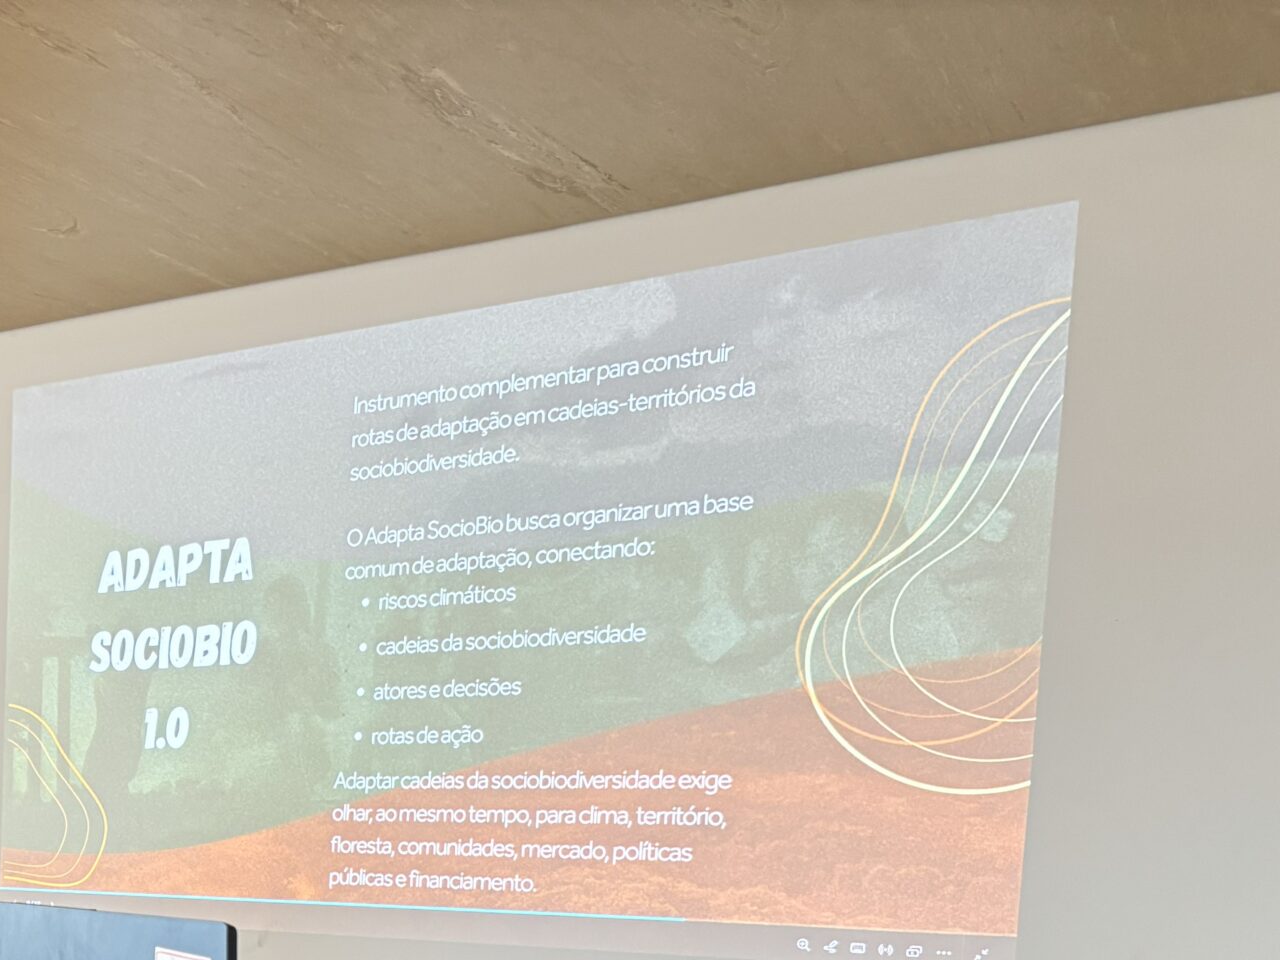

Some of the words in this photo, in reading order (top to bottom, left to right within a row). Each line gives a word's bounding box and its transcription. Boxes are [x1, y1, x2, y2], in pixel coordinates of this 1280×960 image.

[354, 385, 457, 414] Instrumento
[460, 366, 595, 399] complementar
[597, 361, 639, 385] para
[642, 343, 734, 373] construir
[352, 429, 393, 447] rotas
[396, 423, 418, 441] de
[420, 412, 512, 440] adaptação
[514, 410, 545, 426] em
[548, 384, 726, 422] cadeias-territórios
[729, 377, 755, 398] da
[350, 444, 520, 481] sociobiodiversidade.
[347, 528, 363, 547] O
[365, 524, 424, 547] Adapta
[428, 516, 503, 539] SocioBio
[506, 514, 560, 532] busca
[563, 504, 653, 530] organizar
[655, 500, 699, 518] uma
[704, 494, 754, 514] base
[97, 537, 253, 593] ADAPTA
[345, 562, 409, 580] comum
[412, 556, 434, 574] de
[436, 548, 532, 575] adaptação,
[536, 537, 655, 564] conectando:
[379, 593, 427, 610] riscos
[429, 585, 516, 607] climáticos
[89, 620, 257, 673] SOCIOBIO
[377, 636, 438, 655] cadeias
[441, 633, 463, 652] da
[465, 623, 647, 651] sociobiodiversidade
[374, 683, 426, 700] atores
[429, 685, 440, 698] e
[443, 678, 521, 697] decisões
[144, 706, 189, 749] 1.0
[372, 728, 414, 745] rotas
[416, 726, 439, 744] de
[441, 725, 483, 748] ação
[333, 772, 399, 793] Adaptar
[401, 771, 464, 789] cadeias
[467, 771, 488, 789] da
[491, 769, 676, 789] sociobiodiversidade
[678, 771, 733, 795] exige
[333, 804, 373, 824] olhar,
[376, 809, 397, 822] ao
[399, 809, 466, 823] mesmo
[469, 806, 532, 828] tempo,
[536, 810, 576, 828] para
[579, 805, 632, 828] clima,
[636, 805, 726, 829] território,
[331, 836, 395, 857] floresta,
[398, 838, 518, 861] comunidades,
[522, 841, 609, 863] mercado,
[613, 841, 693, 865] políticas
[329, 867, 393, 889] públicas
[395, 874, 407, 887] e
[409, 870, 536, 892] financiamento.
